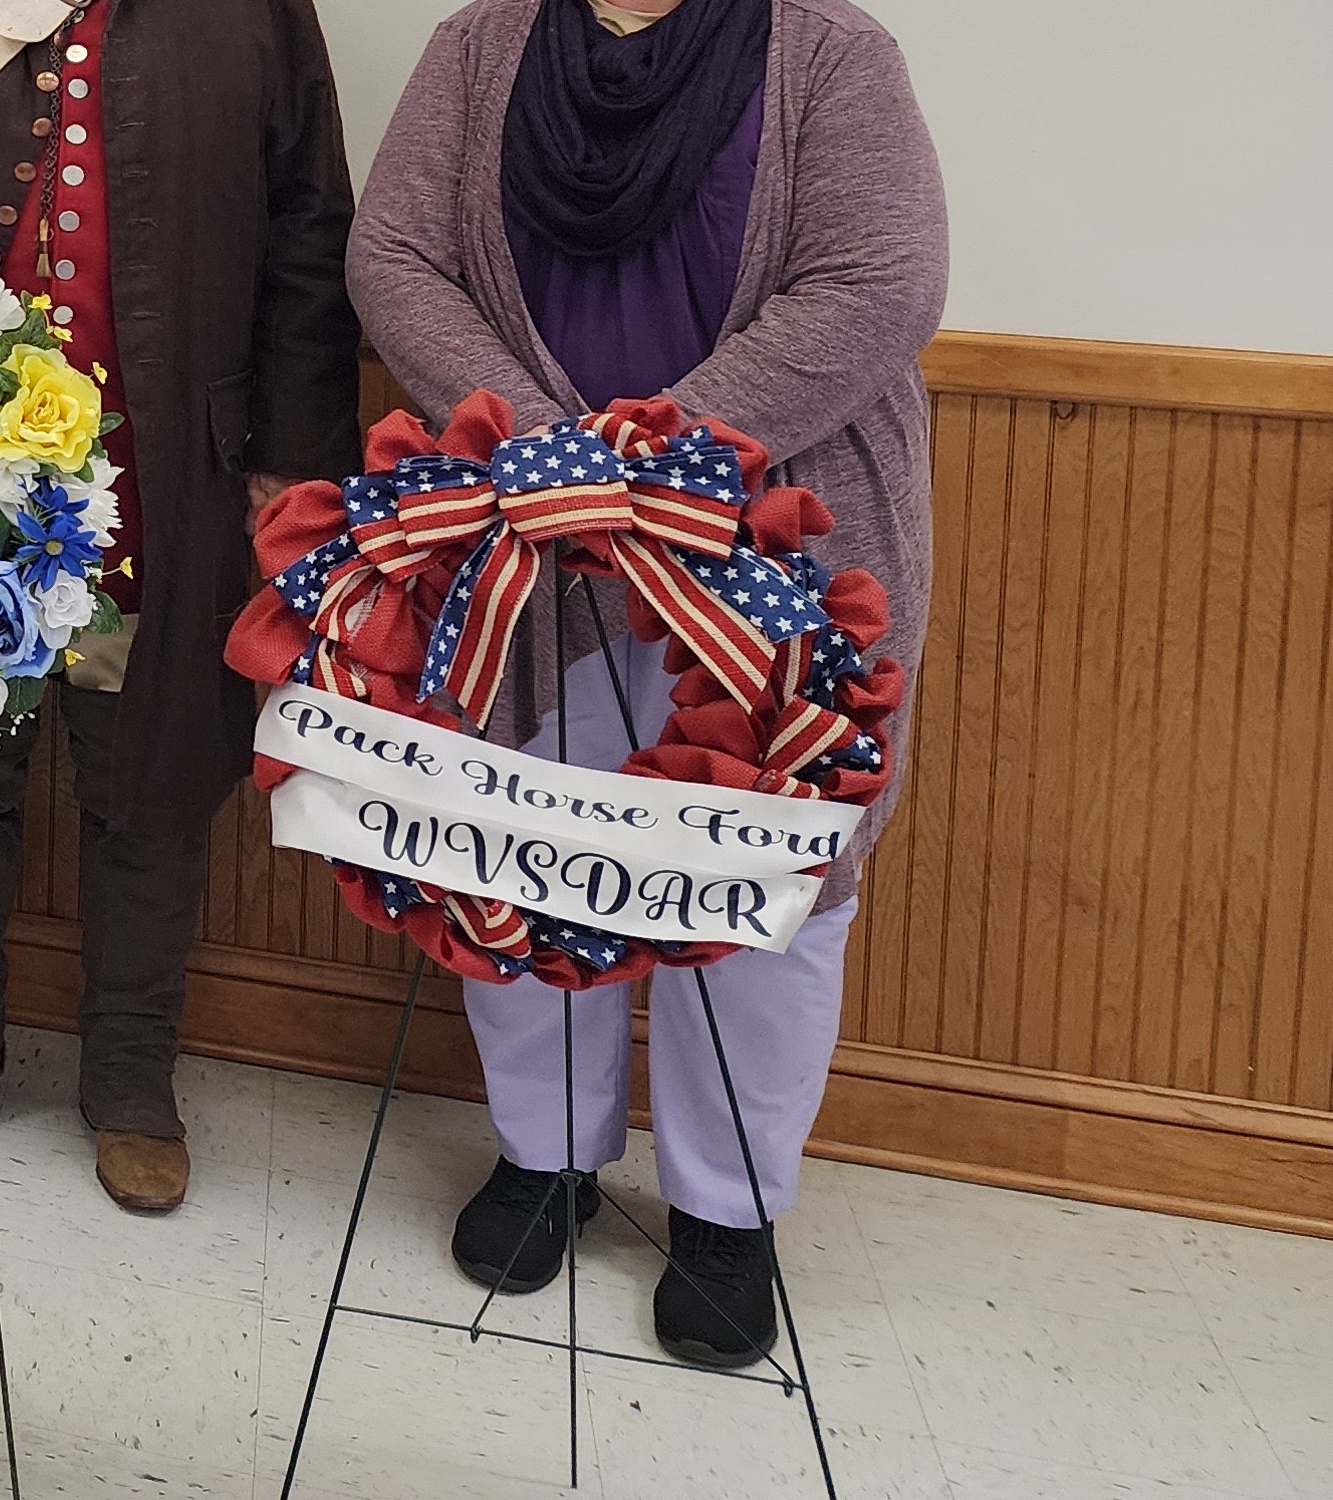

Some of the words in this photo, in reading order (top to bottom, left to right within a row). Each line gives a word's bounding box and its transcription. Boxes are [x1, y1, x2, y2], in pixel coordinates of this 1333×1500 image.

[278, 699, 443, 777] Pack
[460, 760, 659, 830] Horse
[678, 805, 841, 860] Ford
[358, 800, 773, 938] WVSDAR
